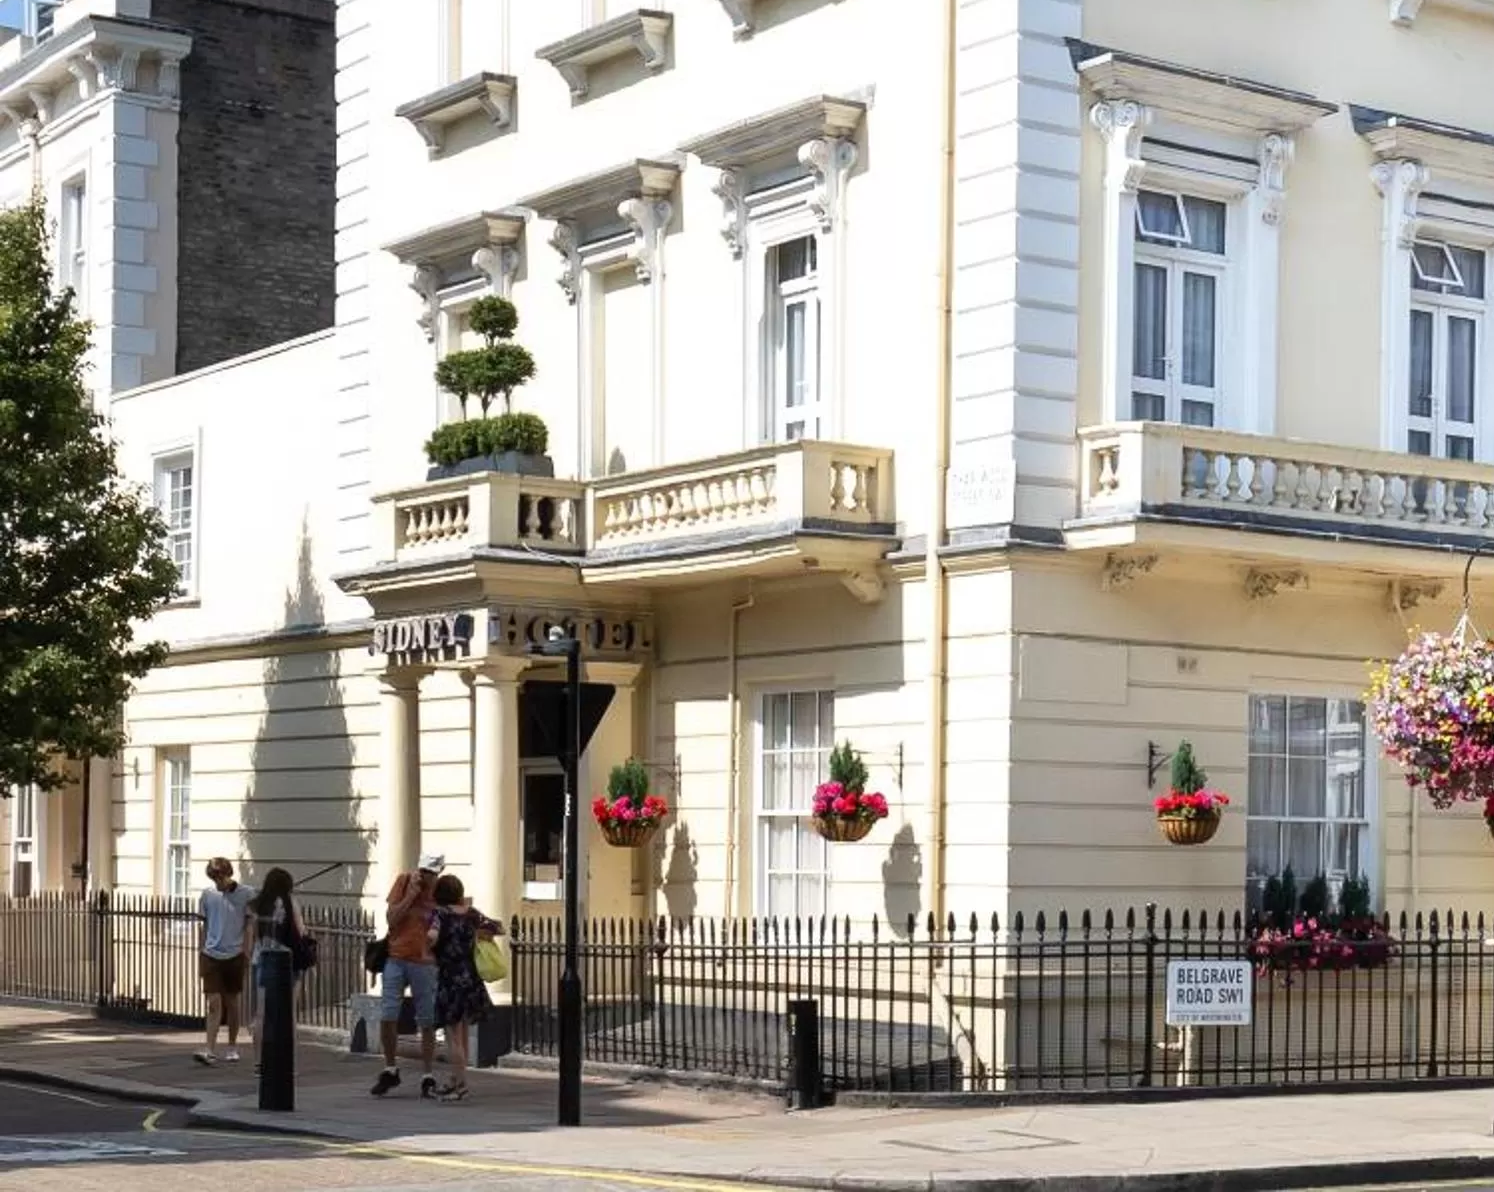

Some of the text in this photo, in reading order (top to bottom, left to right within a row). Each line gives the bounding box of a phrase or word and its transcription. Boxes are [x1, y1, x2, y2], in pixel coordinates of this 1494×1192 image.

[371, 613, 456, 654] SIDNEY
[1176, 968, 1243, 984] BELGRAVE
[1176, 988, 1244, 1005] ROAD SW1
